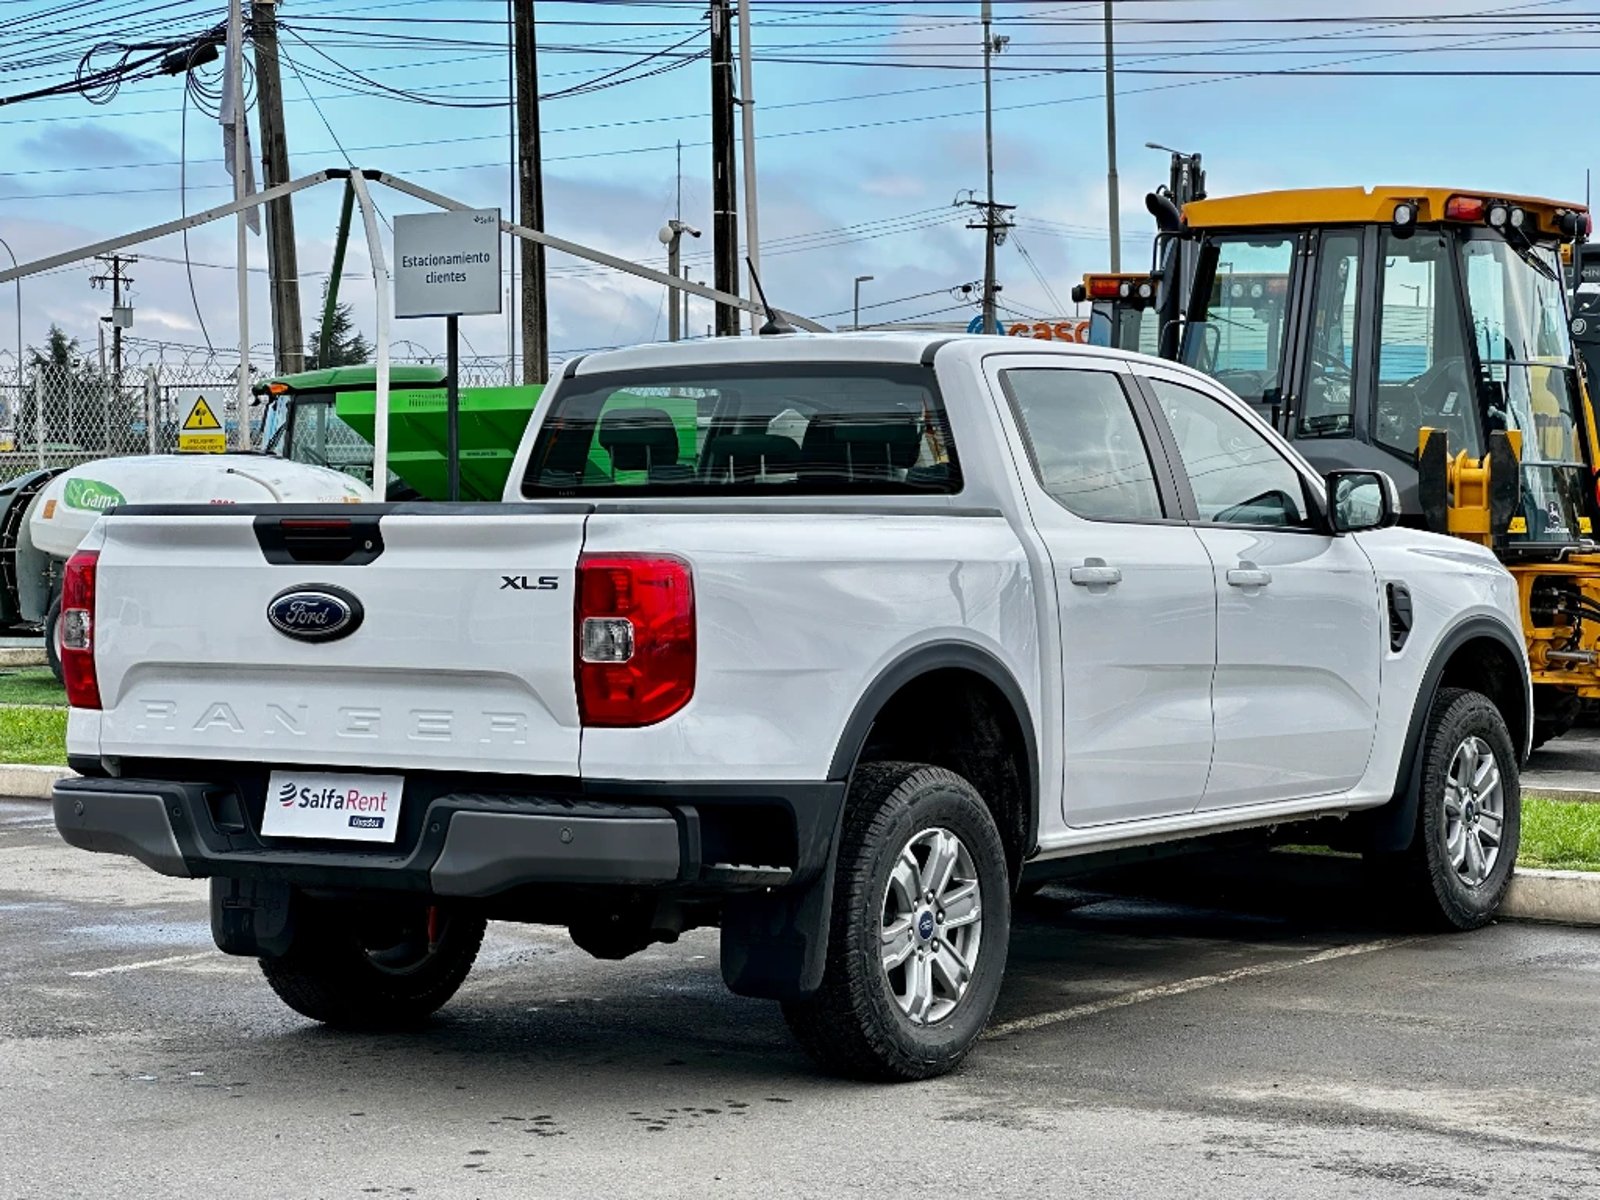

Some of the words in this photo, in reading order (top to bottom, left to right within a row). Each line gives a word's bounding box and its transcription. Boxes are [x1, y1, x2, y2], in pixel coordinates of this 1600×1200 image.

[402, 252, 490, 268] Estacionamiento
[426, 271, 467, 284] clientes
[81, 488, 120, 509] Gama
[500, 576, 559, 590] XLS
[286, 600, 330, 624] Ford
[136, 700, 527, 744] RANGER
